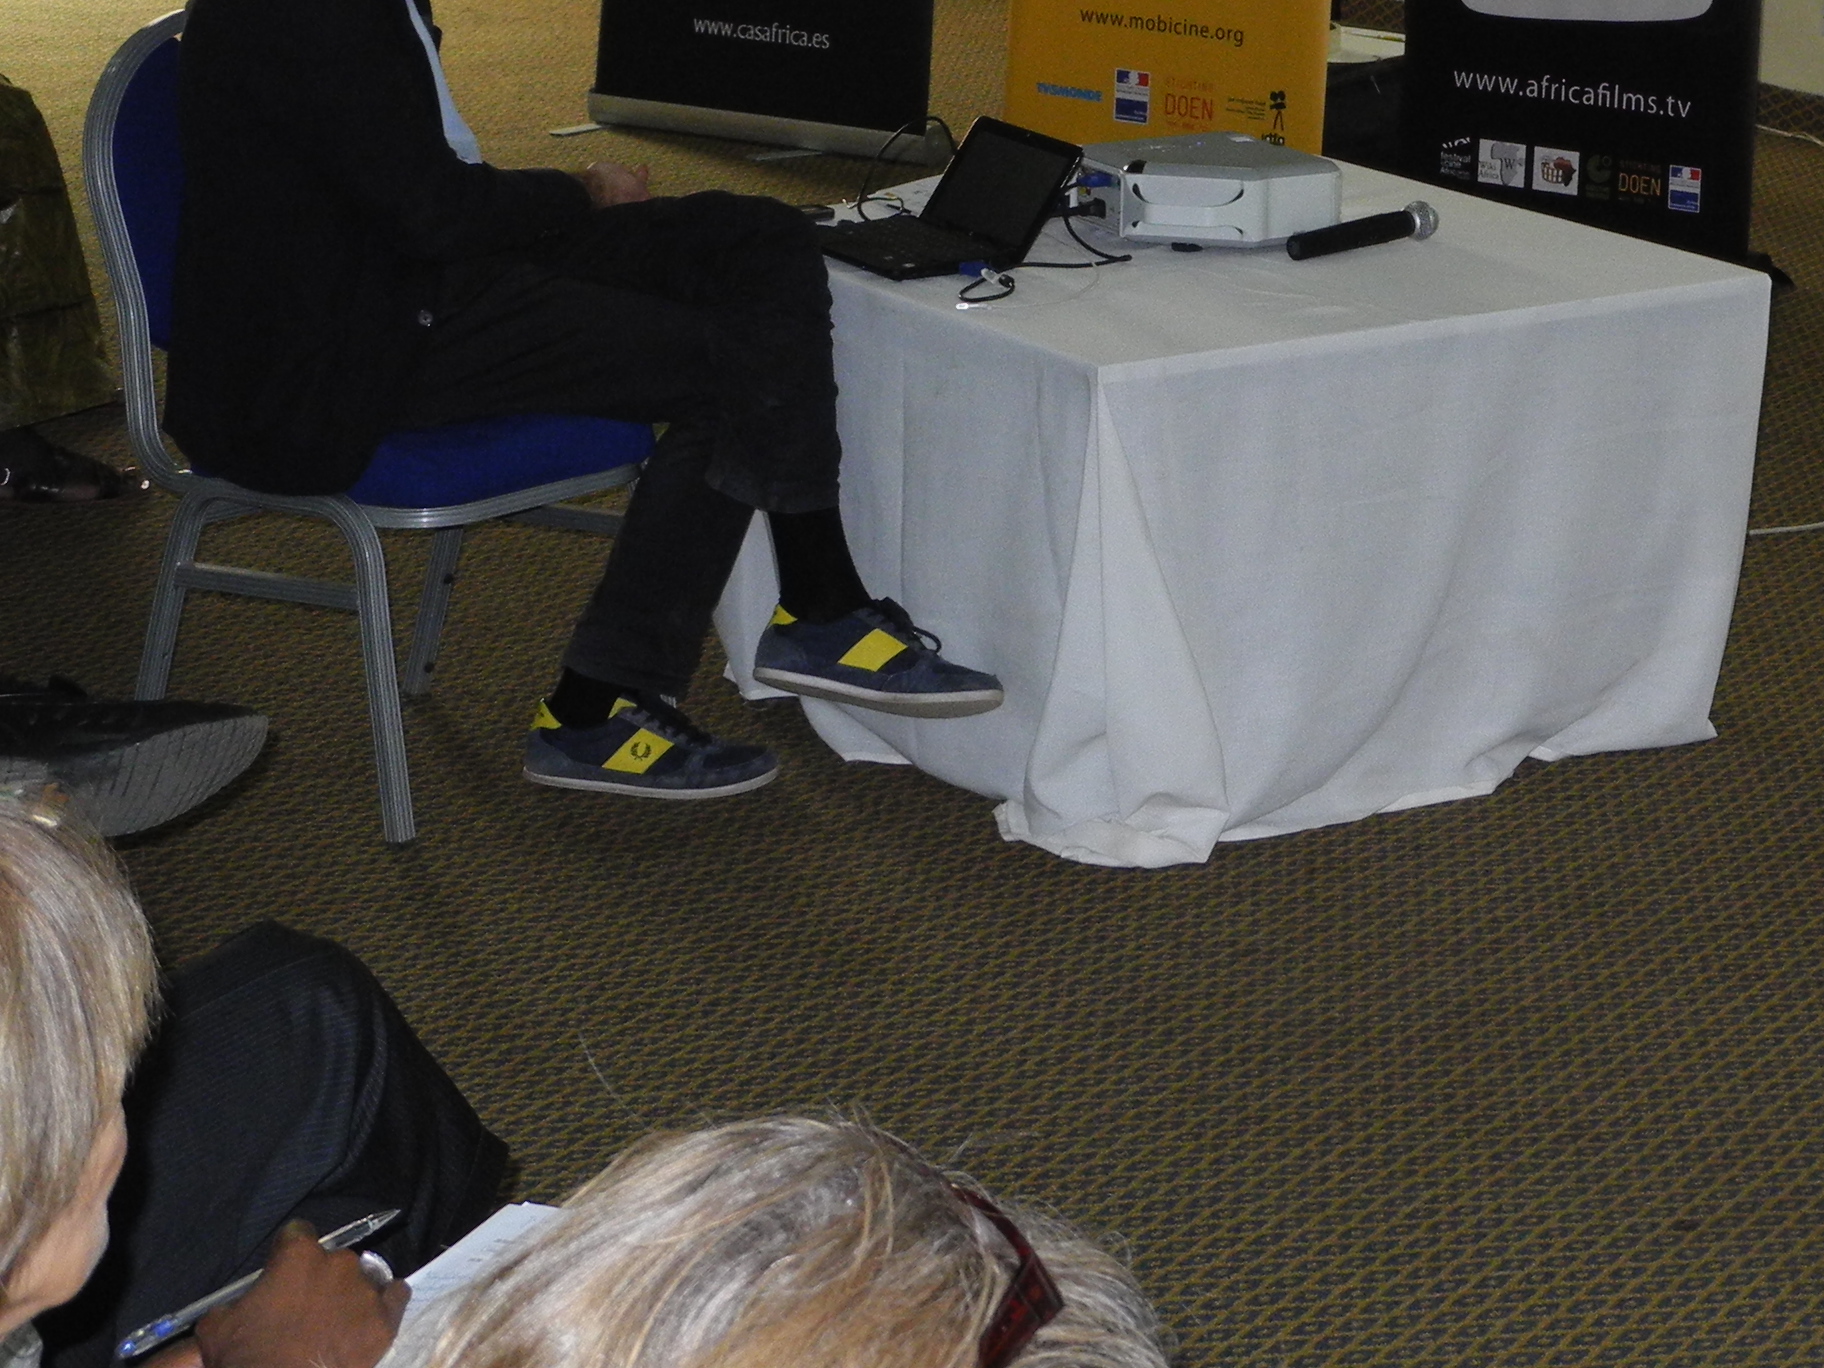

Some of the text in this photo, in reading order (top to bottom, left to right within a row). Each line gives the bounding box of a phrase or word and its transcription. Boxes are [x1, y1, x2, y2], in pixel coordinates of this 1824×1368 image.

[693, 18, 830, 49] www.casafrica.es
[1080, 8, 1245, 47] www.mobicine.org
[1164, 93, 1214, 121] DOEN
[1454, 70, 1692, 118] www.africafilms.tv
[1617, 172, 1662, 197] DOEN
